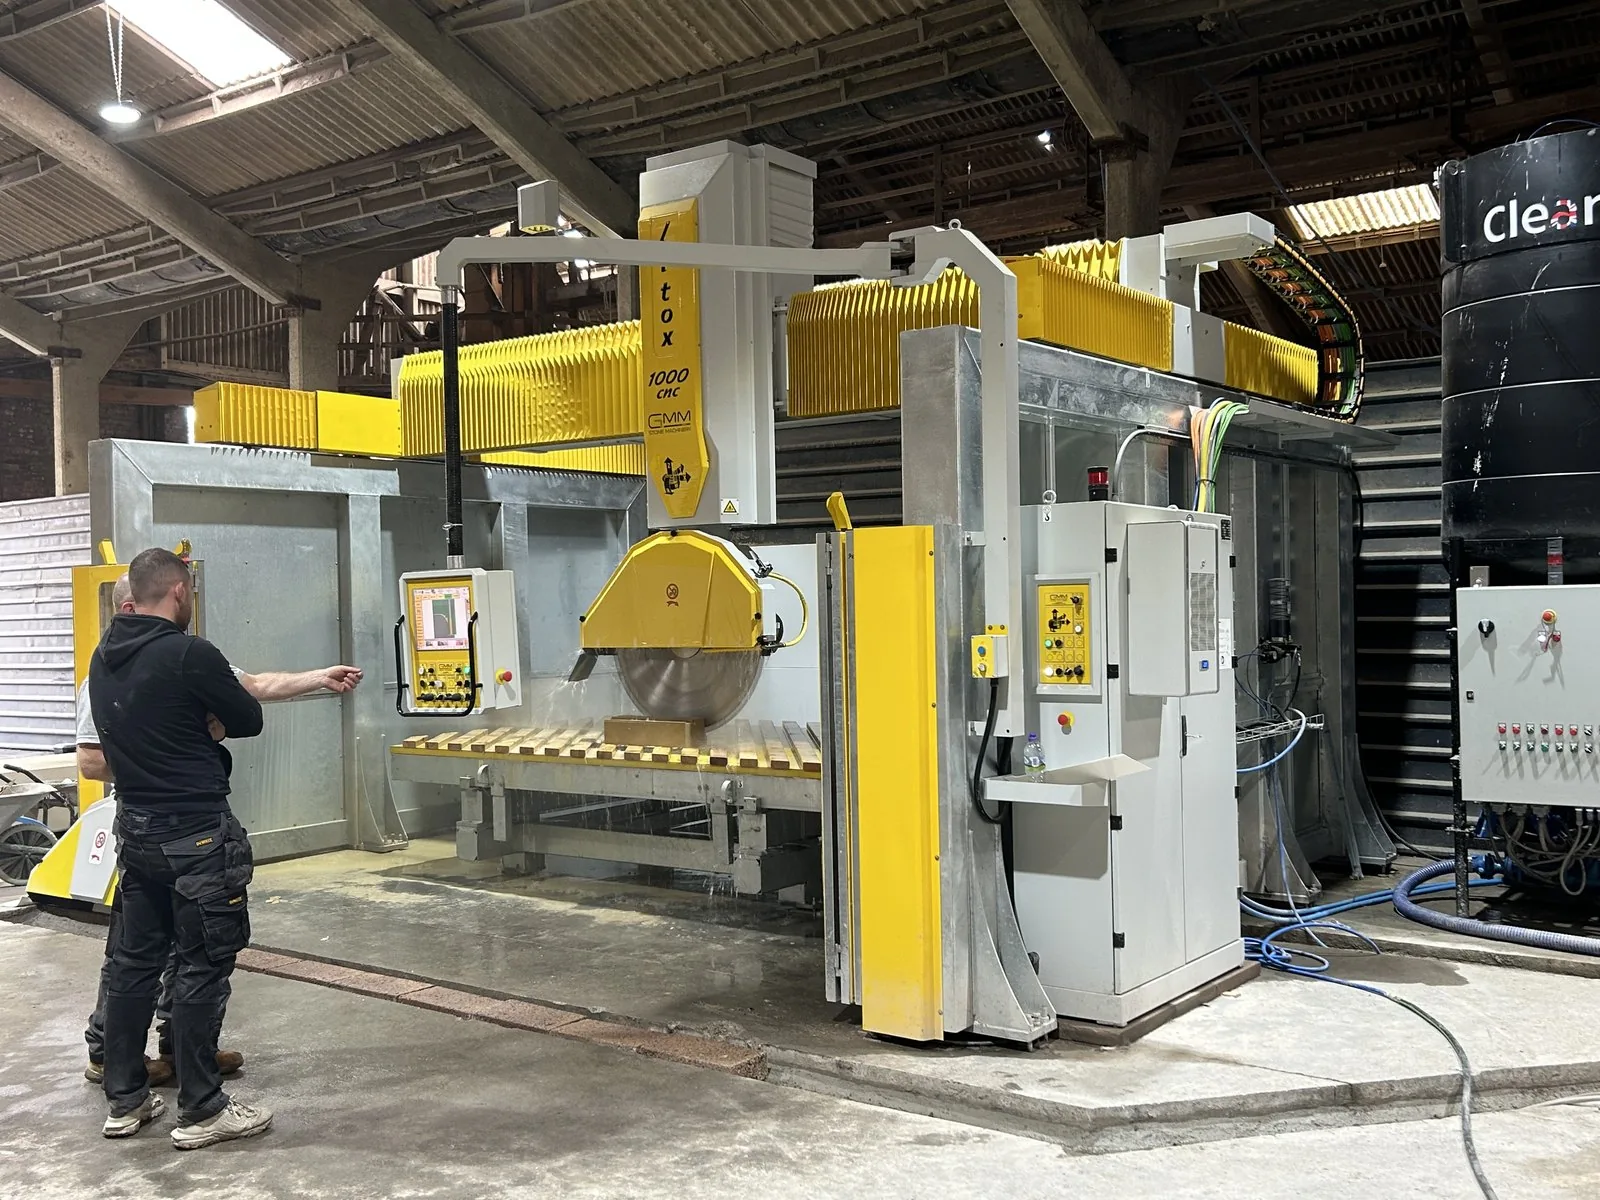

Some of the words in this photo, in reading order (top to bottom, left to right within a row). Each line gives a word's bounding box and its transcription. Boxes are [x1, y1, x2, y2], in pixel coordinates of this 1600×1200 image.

[648, 368, 689, 387] 1000
[657, 387, 681, 399] cnc
[648, 410, 691, 429] GMM
